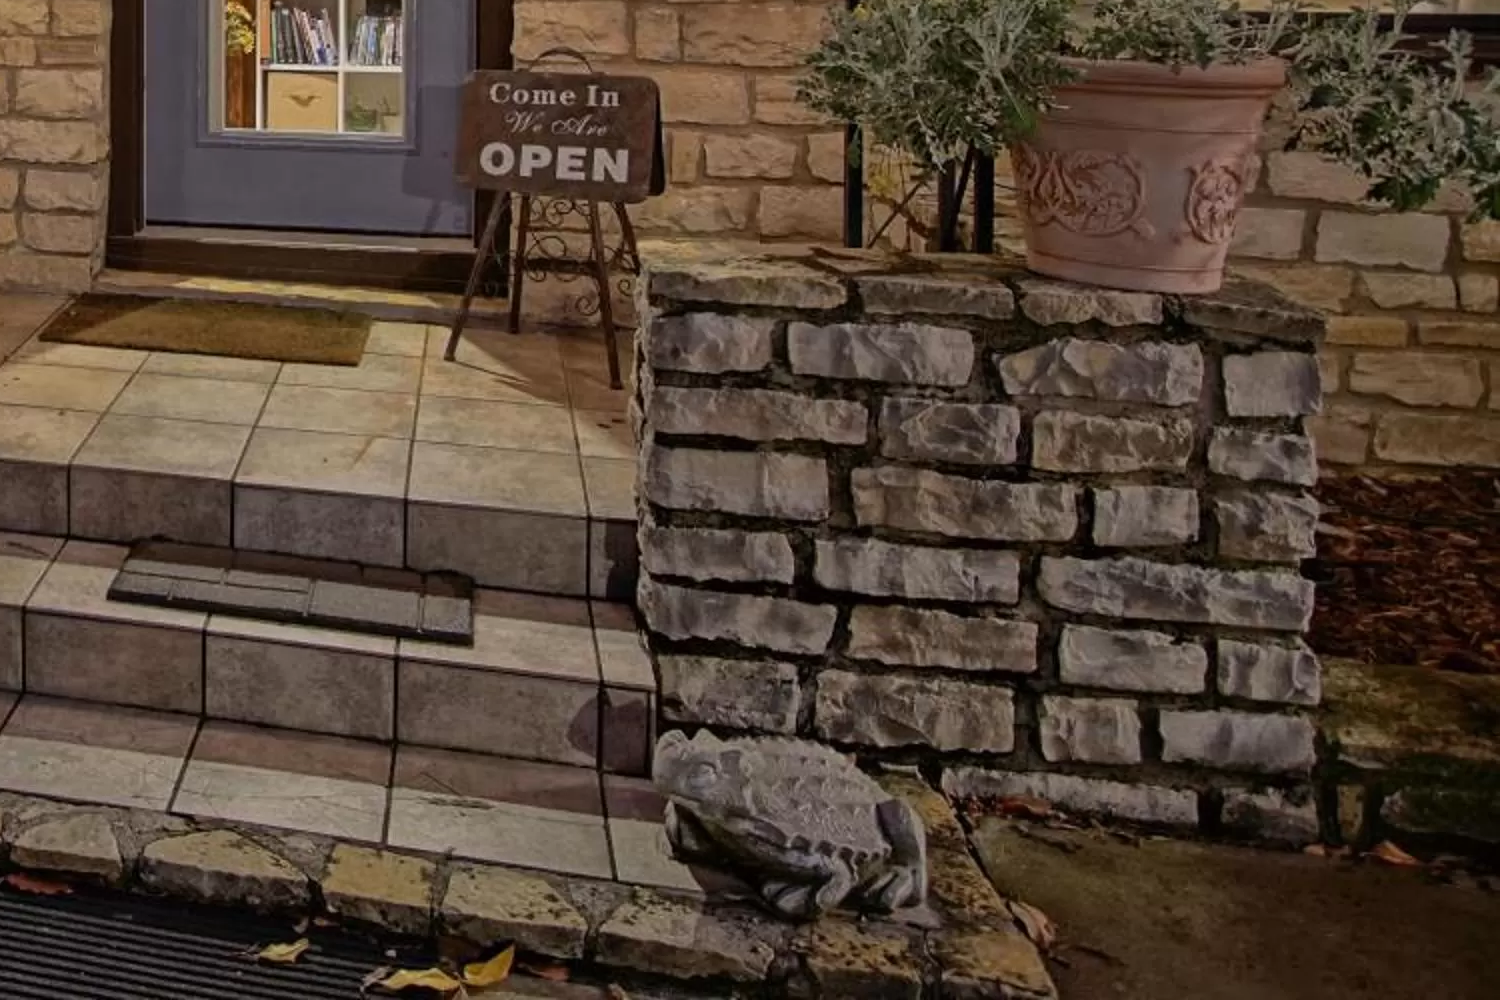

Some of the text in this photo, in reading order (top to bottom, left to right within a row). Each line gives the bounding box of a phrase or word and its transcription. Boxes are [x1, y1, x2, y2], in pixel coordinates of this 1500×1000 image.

[489, 82, 621, 108] Come In
[504, 110, 609, 137] We Are
[479, 141, 630, 183] OPEN
